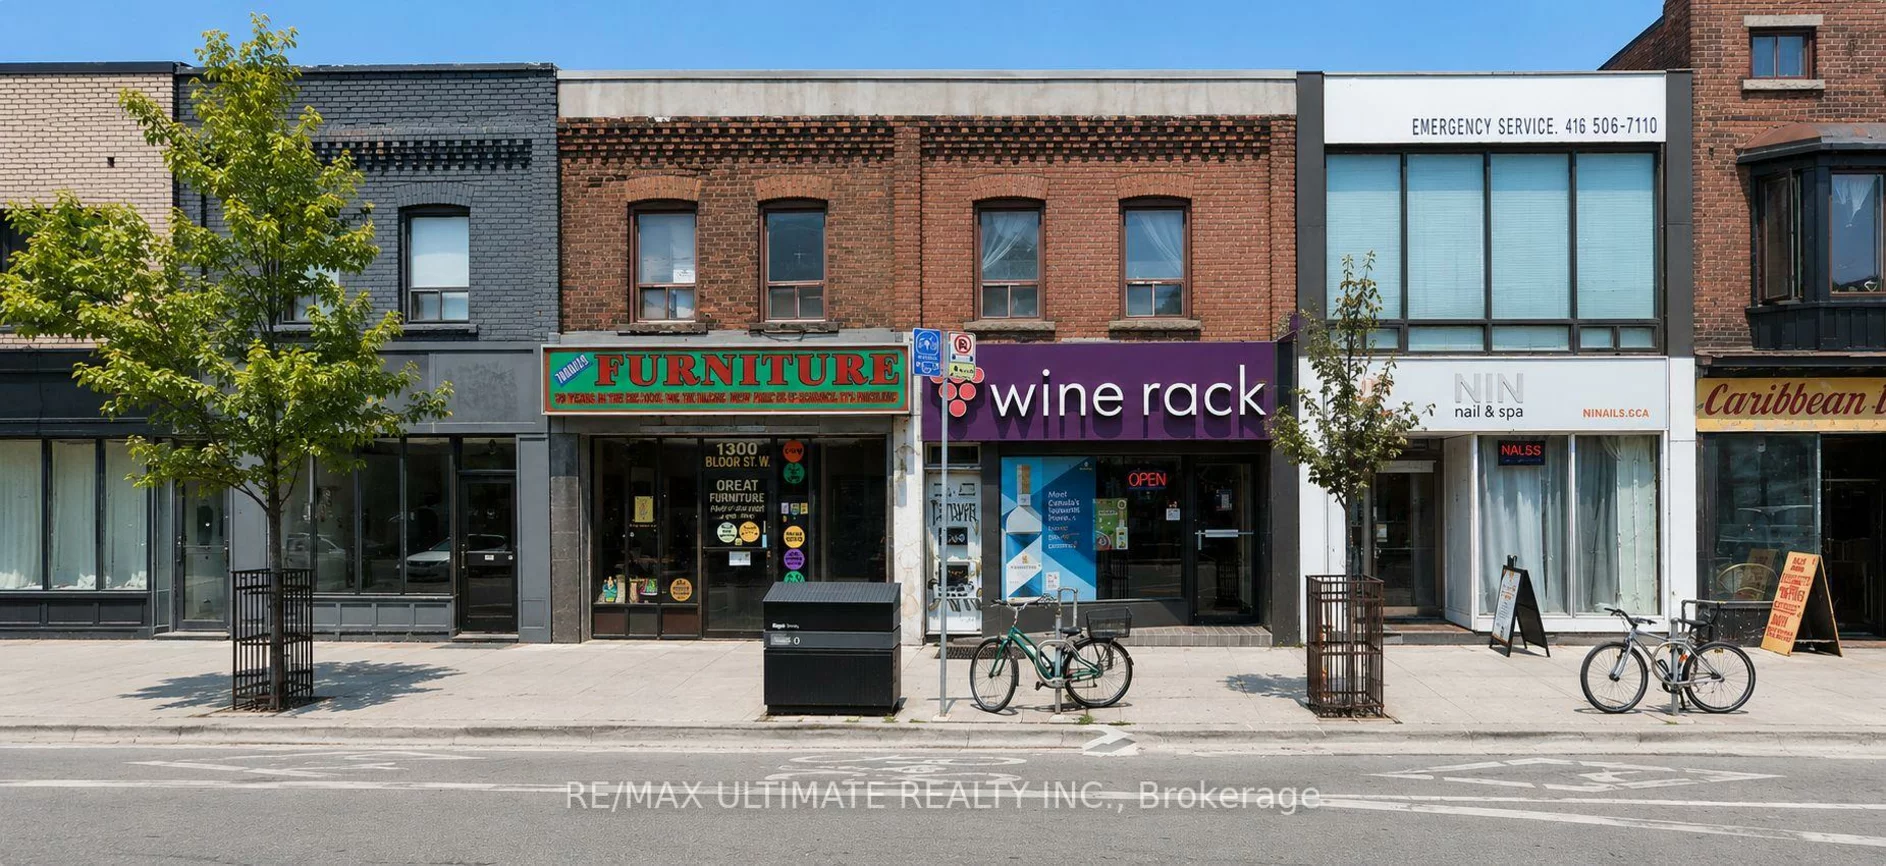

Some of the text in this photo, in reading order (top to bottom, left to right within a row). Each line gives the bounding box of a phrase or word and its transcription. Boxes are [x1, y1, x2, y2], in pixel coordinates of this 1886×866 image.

[1412, 117, 1658, 136] EMERGENCY SERVICE. 416 506-7110
[594, 353, 900, 386] FURNITURE
[989, 364, 1267, 417] wine rack
[1454, 373, 1524, 404] NIN
[1704, 382, 1867, 415] Caribbean
[1455, 405, 1524, 421] nail & spa
[716, 442, 758, 456] 1300
[705, 456, 771, 467] BLOOR ST. W.
[1128, 472, 1167, 487] OPEN
[709, 493, 765, 503] FURNITURE
